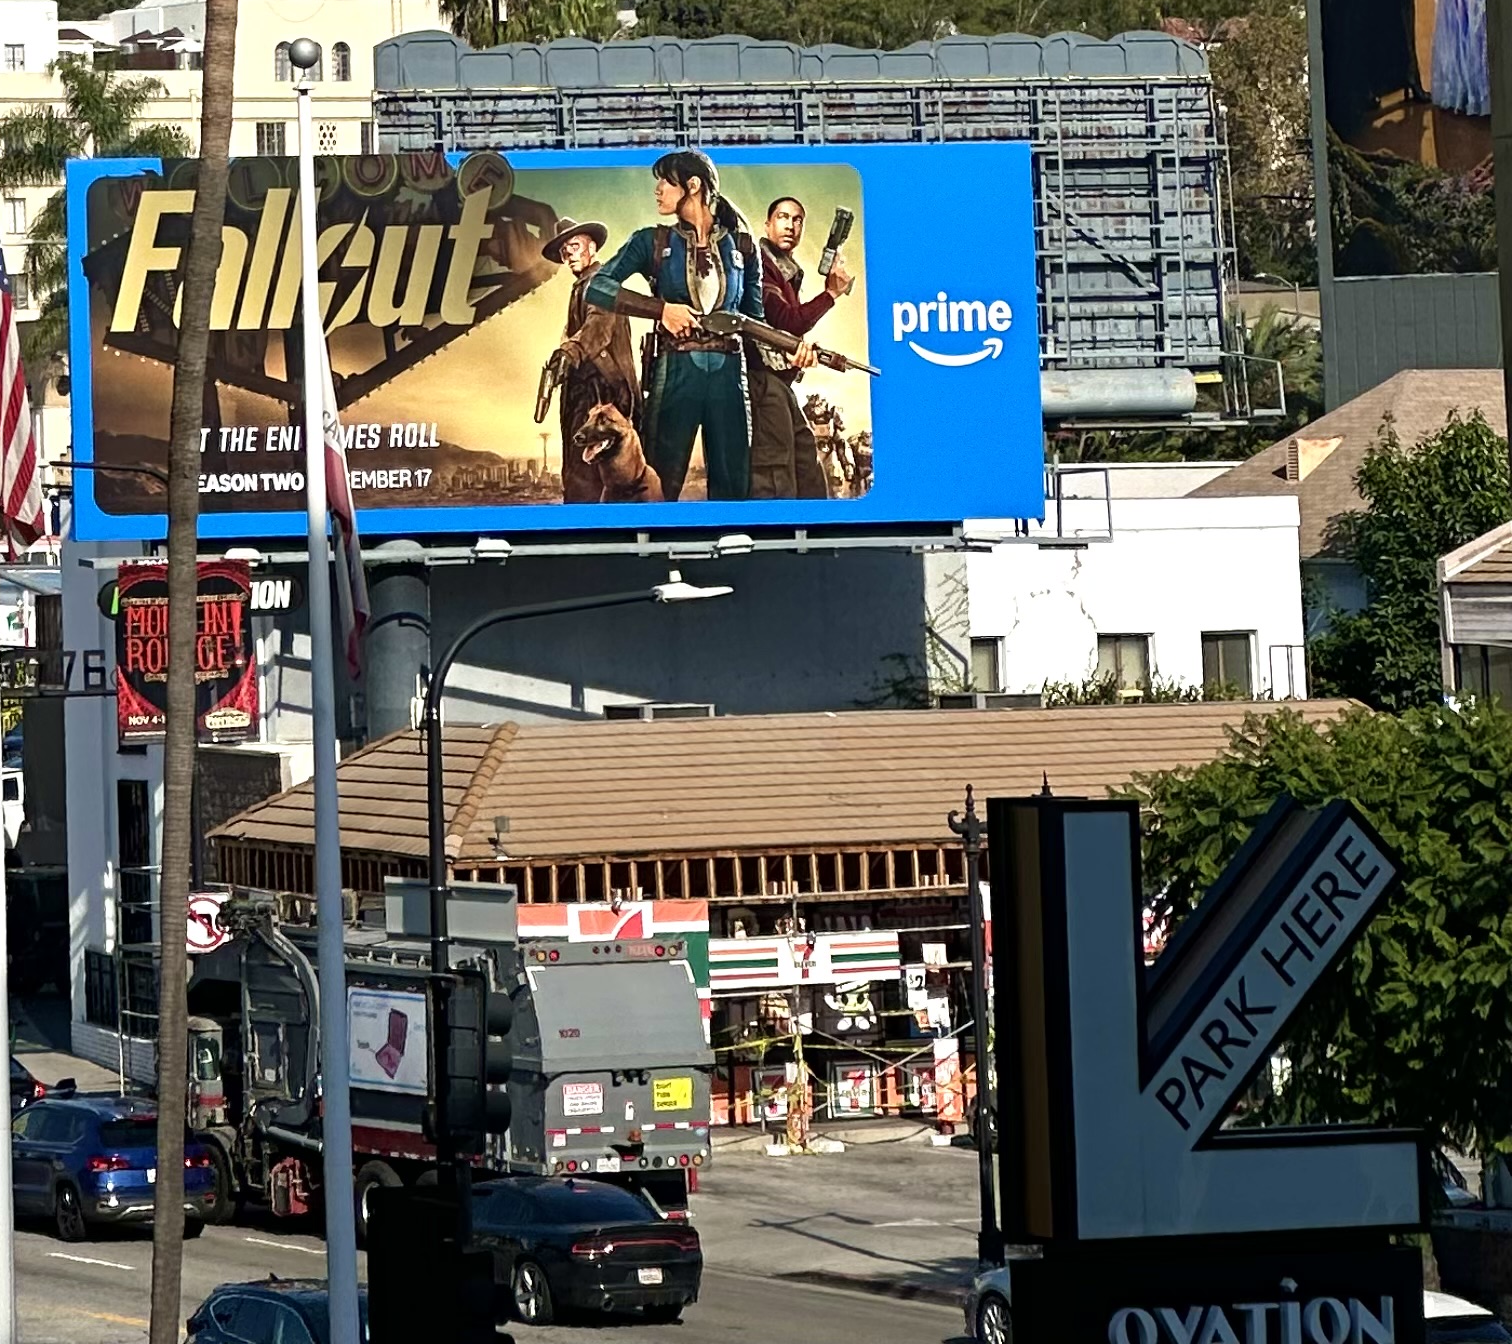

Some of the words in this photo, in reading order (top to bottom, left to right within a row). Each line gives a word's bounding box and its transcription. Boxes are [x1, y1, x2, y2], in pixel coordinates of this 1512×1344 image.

[892, 291, 1013, 342] prime
[219, 426, 259, 452] THE
[265, 425, 301, 452] EN
[388, 421, 441, 449] ROLL
[198, 473, 259, 494] EASON
[259, 472, 305, 492] TWO
[347, 469, 413, 490] EMBER
[414, 468, 433, 489] 17
[129, 715, 150, 725] NOV
[1155, 975, 1276, 1131] PARK
[1261, 835, 1381, 988] HERE
